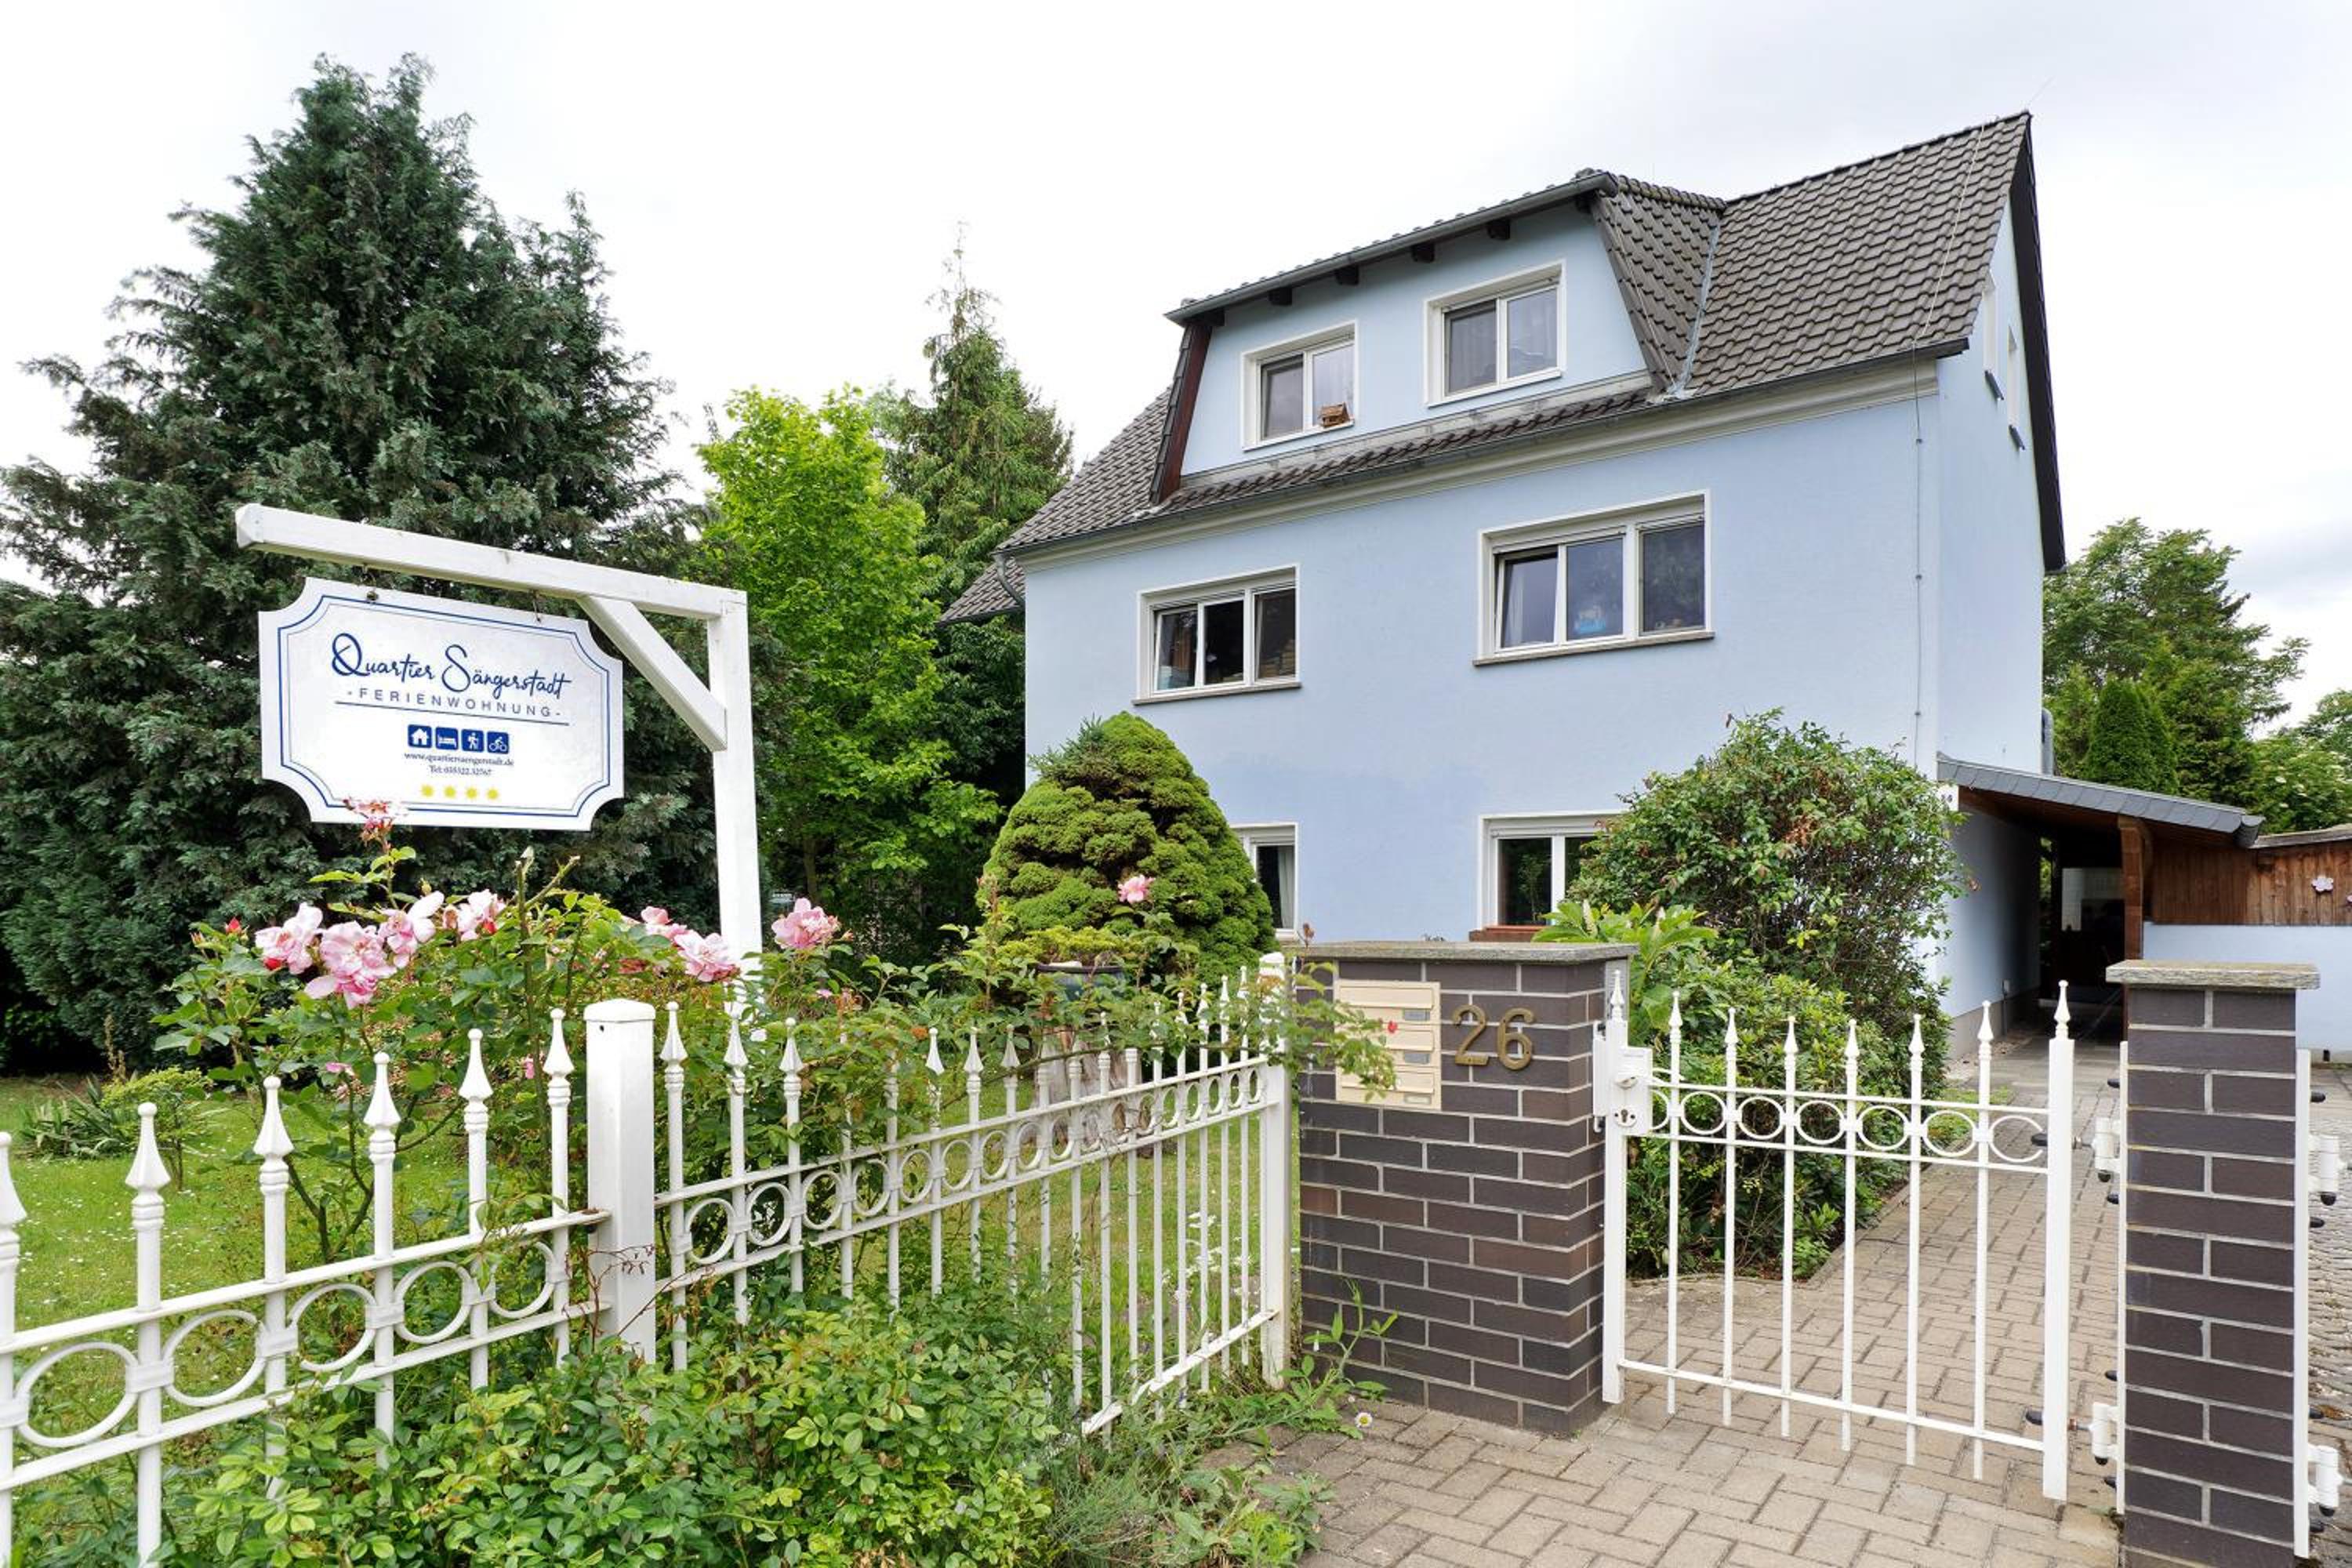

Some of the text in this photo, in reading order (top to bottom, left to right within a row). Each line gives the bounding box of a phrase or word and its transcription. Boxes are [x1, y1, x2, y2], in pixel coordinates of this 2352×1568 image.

[332, 633, 572, 699] Quartier Sängerstadt
[1453, 1004, 1534, 1071] 26
